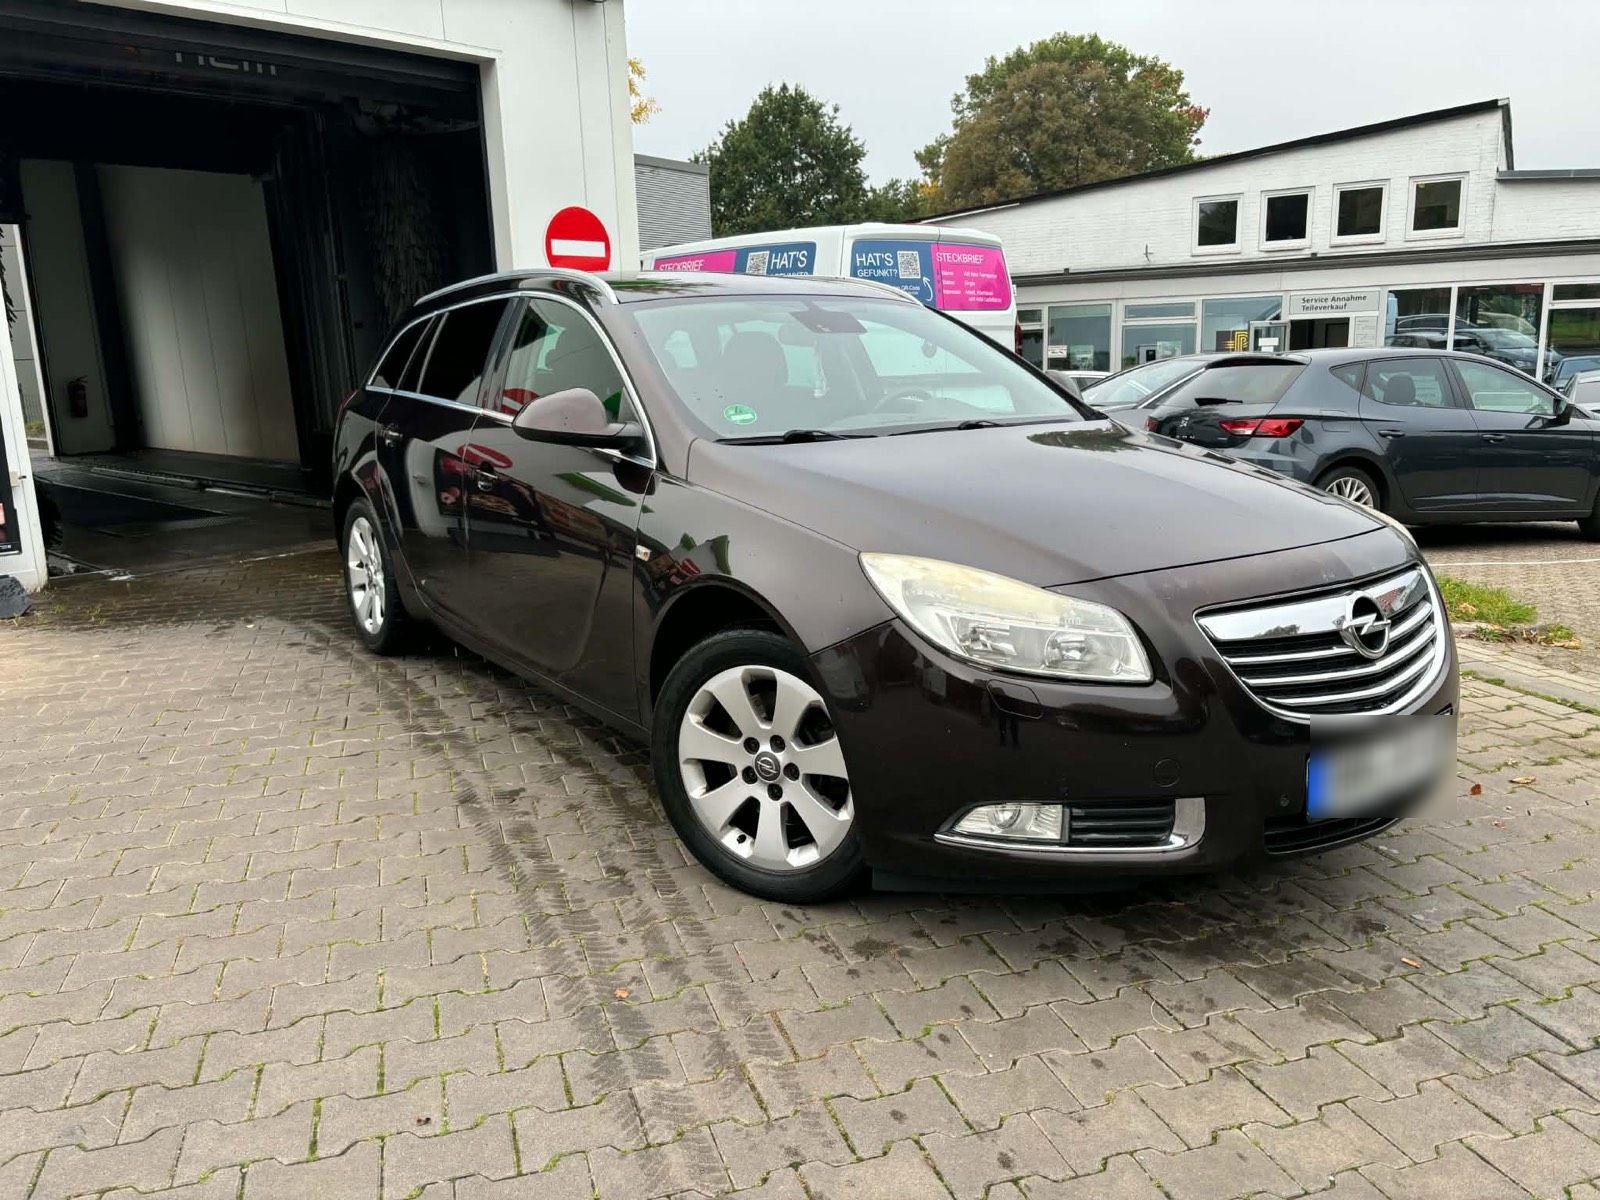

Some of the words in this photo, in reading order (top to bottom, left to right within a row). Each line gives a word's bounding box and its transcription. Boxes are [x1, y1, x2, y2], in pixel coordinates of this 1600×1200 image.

[770, 250, 808, 270] HAT'S
[855, 252, 894, 267] HAT'S
[936, 252, 985, 264] STECKBRIEF
[857, 268, 898, 278] GEFUNKT?
[1302, 296, 1328, 304] Service
[1331, 294, 1366, 302] Annahme
[1302, 303, 1347, 311] Teileverkauf
